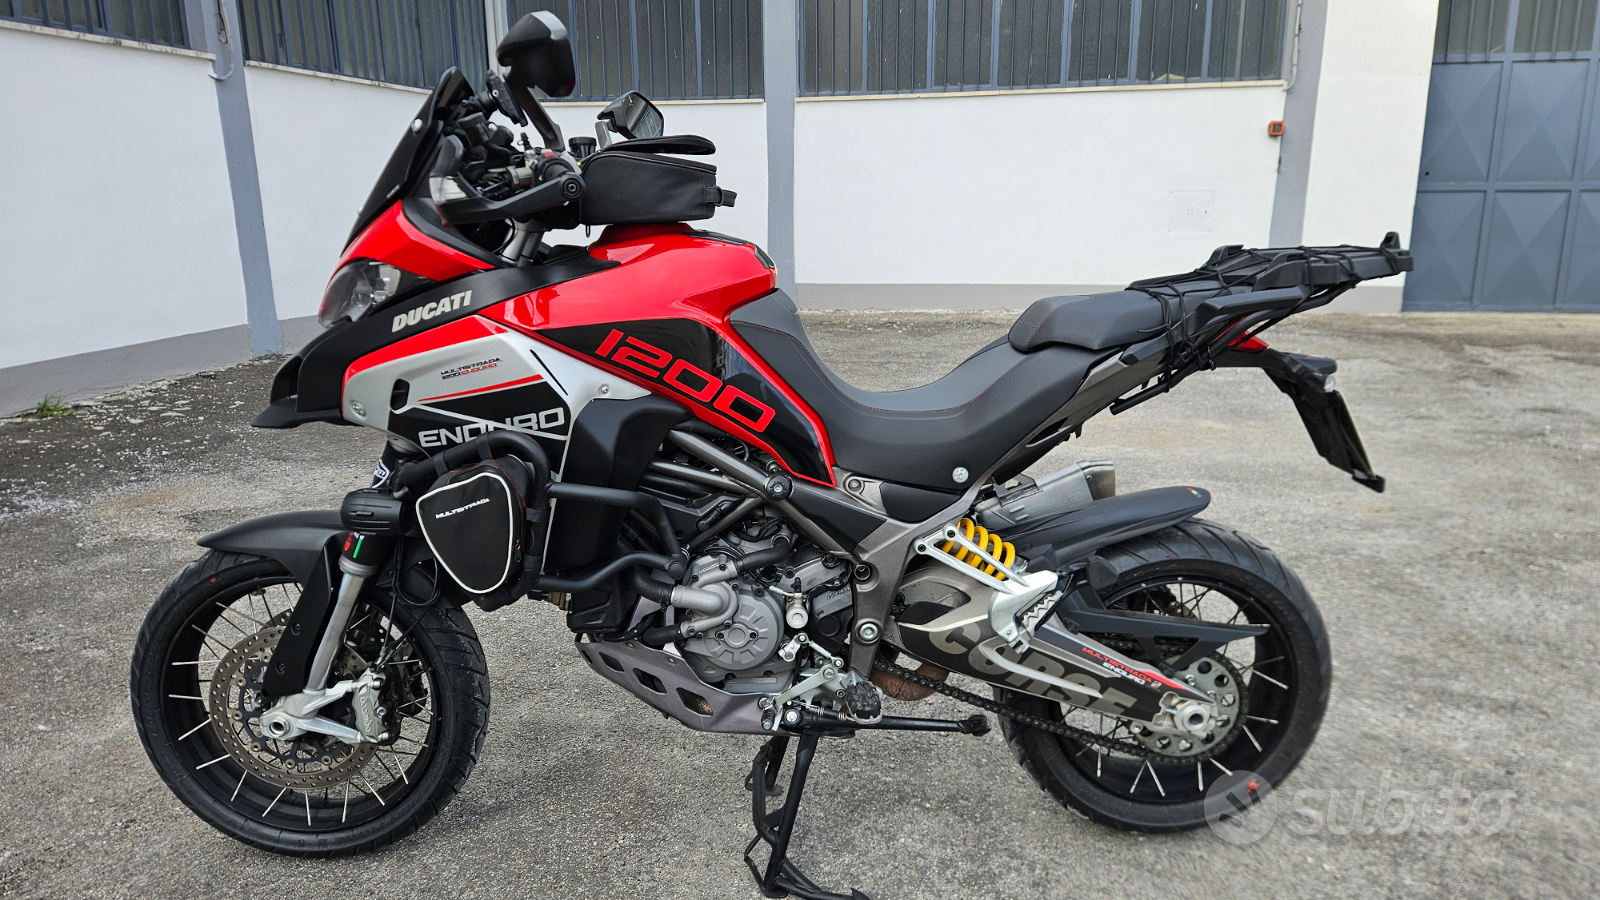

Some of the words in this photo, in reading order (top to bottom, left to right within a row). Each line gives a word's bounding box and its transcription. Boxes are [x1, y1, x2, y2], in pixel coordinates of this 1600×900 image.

[391, 290, 473, 333] DUCATI
[440, 357, 502, 375] MULTISTRADA
[594, 328, 776, 433] 1200
[435, 497, 490, 519] MULTISTRADA
[1082, 646, 1152, 683] MULTISTRADA
[1102, 661, 1146, 686] ENDURO
